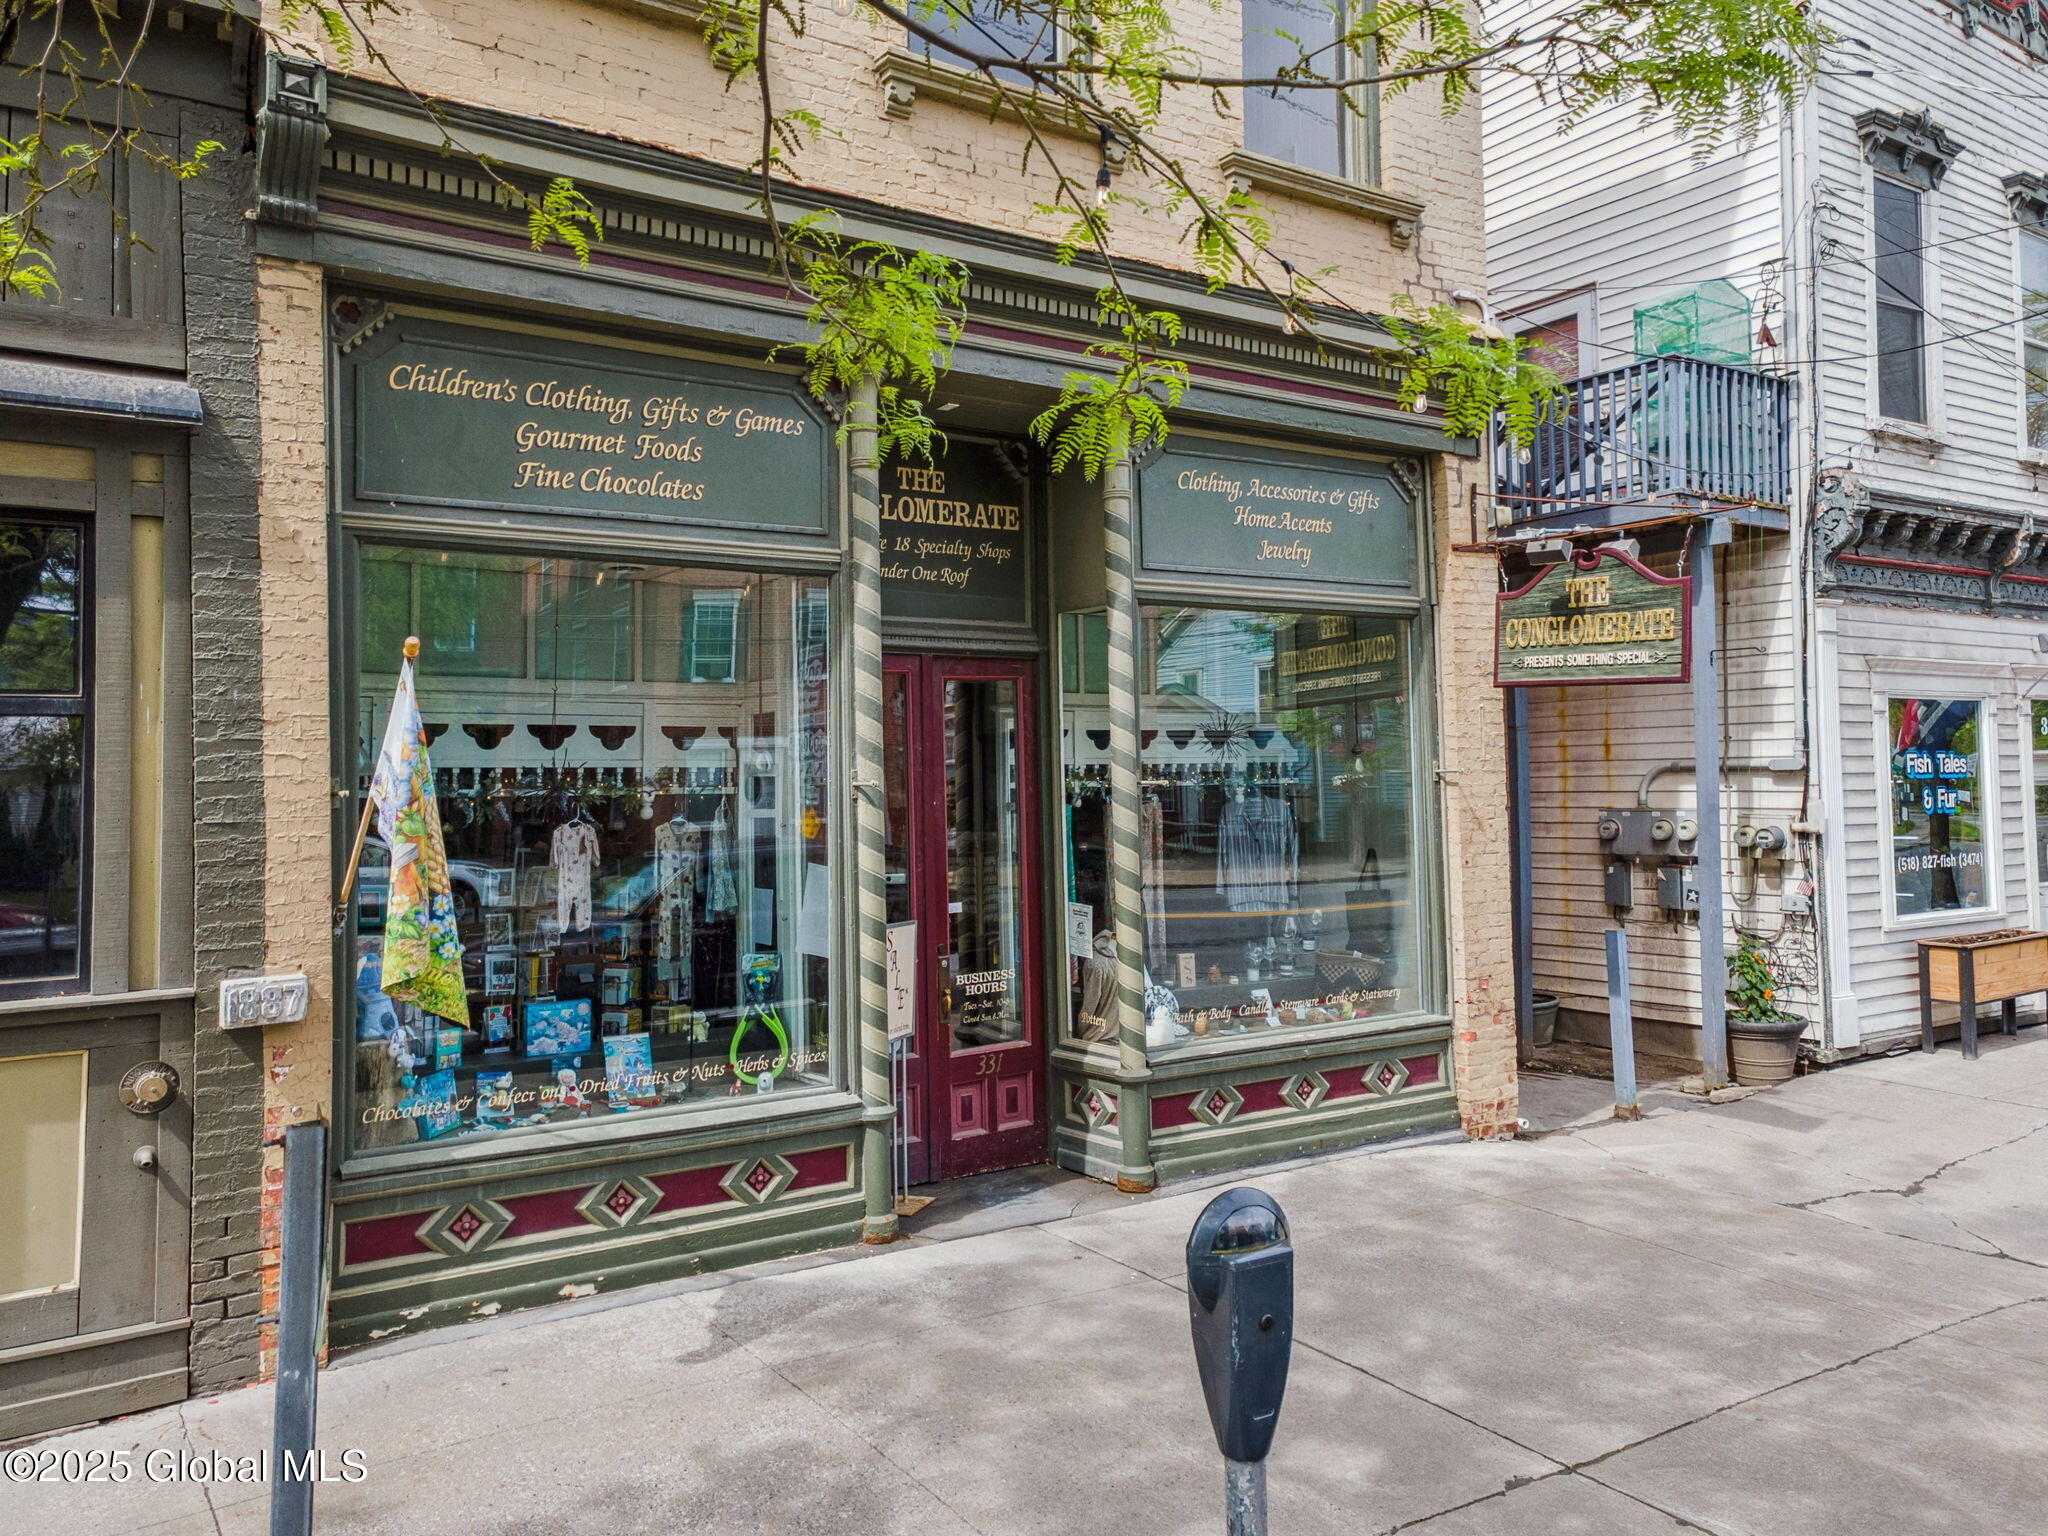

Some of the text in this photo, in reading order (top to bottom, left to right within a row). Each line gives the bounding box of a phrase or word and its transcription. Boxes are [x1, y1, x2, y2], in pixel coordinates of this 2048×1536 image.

[389, 363, 805, 437] Children's Clothing, Gifts & Games
[515, 422, 703, 463] Gourmet Foods
[513, 461, 704, 501] Fine Chocolates
[897, 467, 945, 494] THE
[1177, 469, 1380, 514] Clothing, Accessories & Gifts
[879, 494, 1020, 531] LOMERATE
[1234, 505, 1332, 534] Home Accents
[894, 537, 911, 551] 18
[915, 539, 972, 561] Specialty
[977, 542, 1011, 564] Shops
[1257, 540, 1312, 568] Jewelry
[880, 563, 972, 589] nder One Roof
[1566, 576, 1610, 608] THE
[1505, 608, 1676, 649] CONGLOMERATE
[1524, 651, 1651, 668] PRESENTS SOMETHING SPECIAL
[1905, 751, 1968, 777] Fish Tales
[1936, 787, 1957, 810] Fur
[1897, 851, 1984, 873] (518) 827-fish (3474)
[956, 968, 1016, 985] BUSINESS
[965, 981, 1007, 996] HOURS
[228, 983, 304, 1022] 1887
[1196, 1009, 1208, 1022] &
[1208, 1004, 1232, 1023] Body
[1239, 999, 1270, 1016] Candle
[1280, 998, 1319, 1011] Stemware
[1326, 990, 1350, 1005] Cards
[1349, 992, 1359, 1002] &
[1360, 988, 1400, 1001] Stationery
[1081, 1011, 1106, 1032] Pottery
[976, 1053, 1003, 1075] 331
[362, 1051, 827, 1124] Chocolates & Confecton Dried Fruits & Nuts Herbs & Spices
